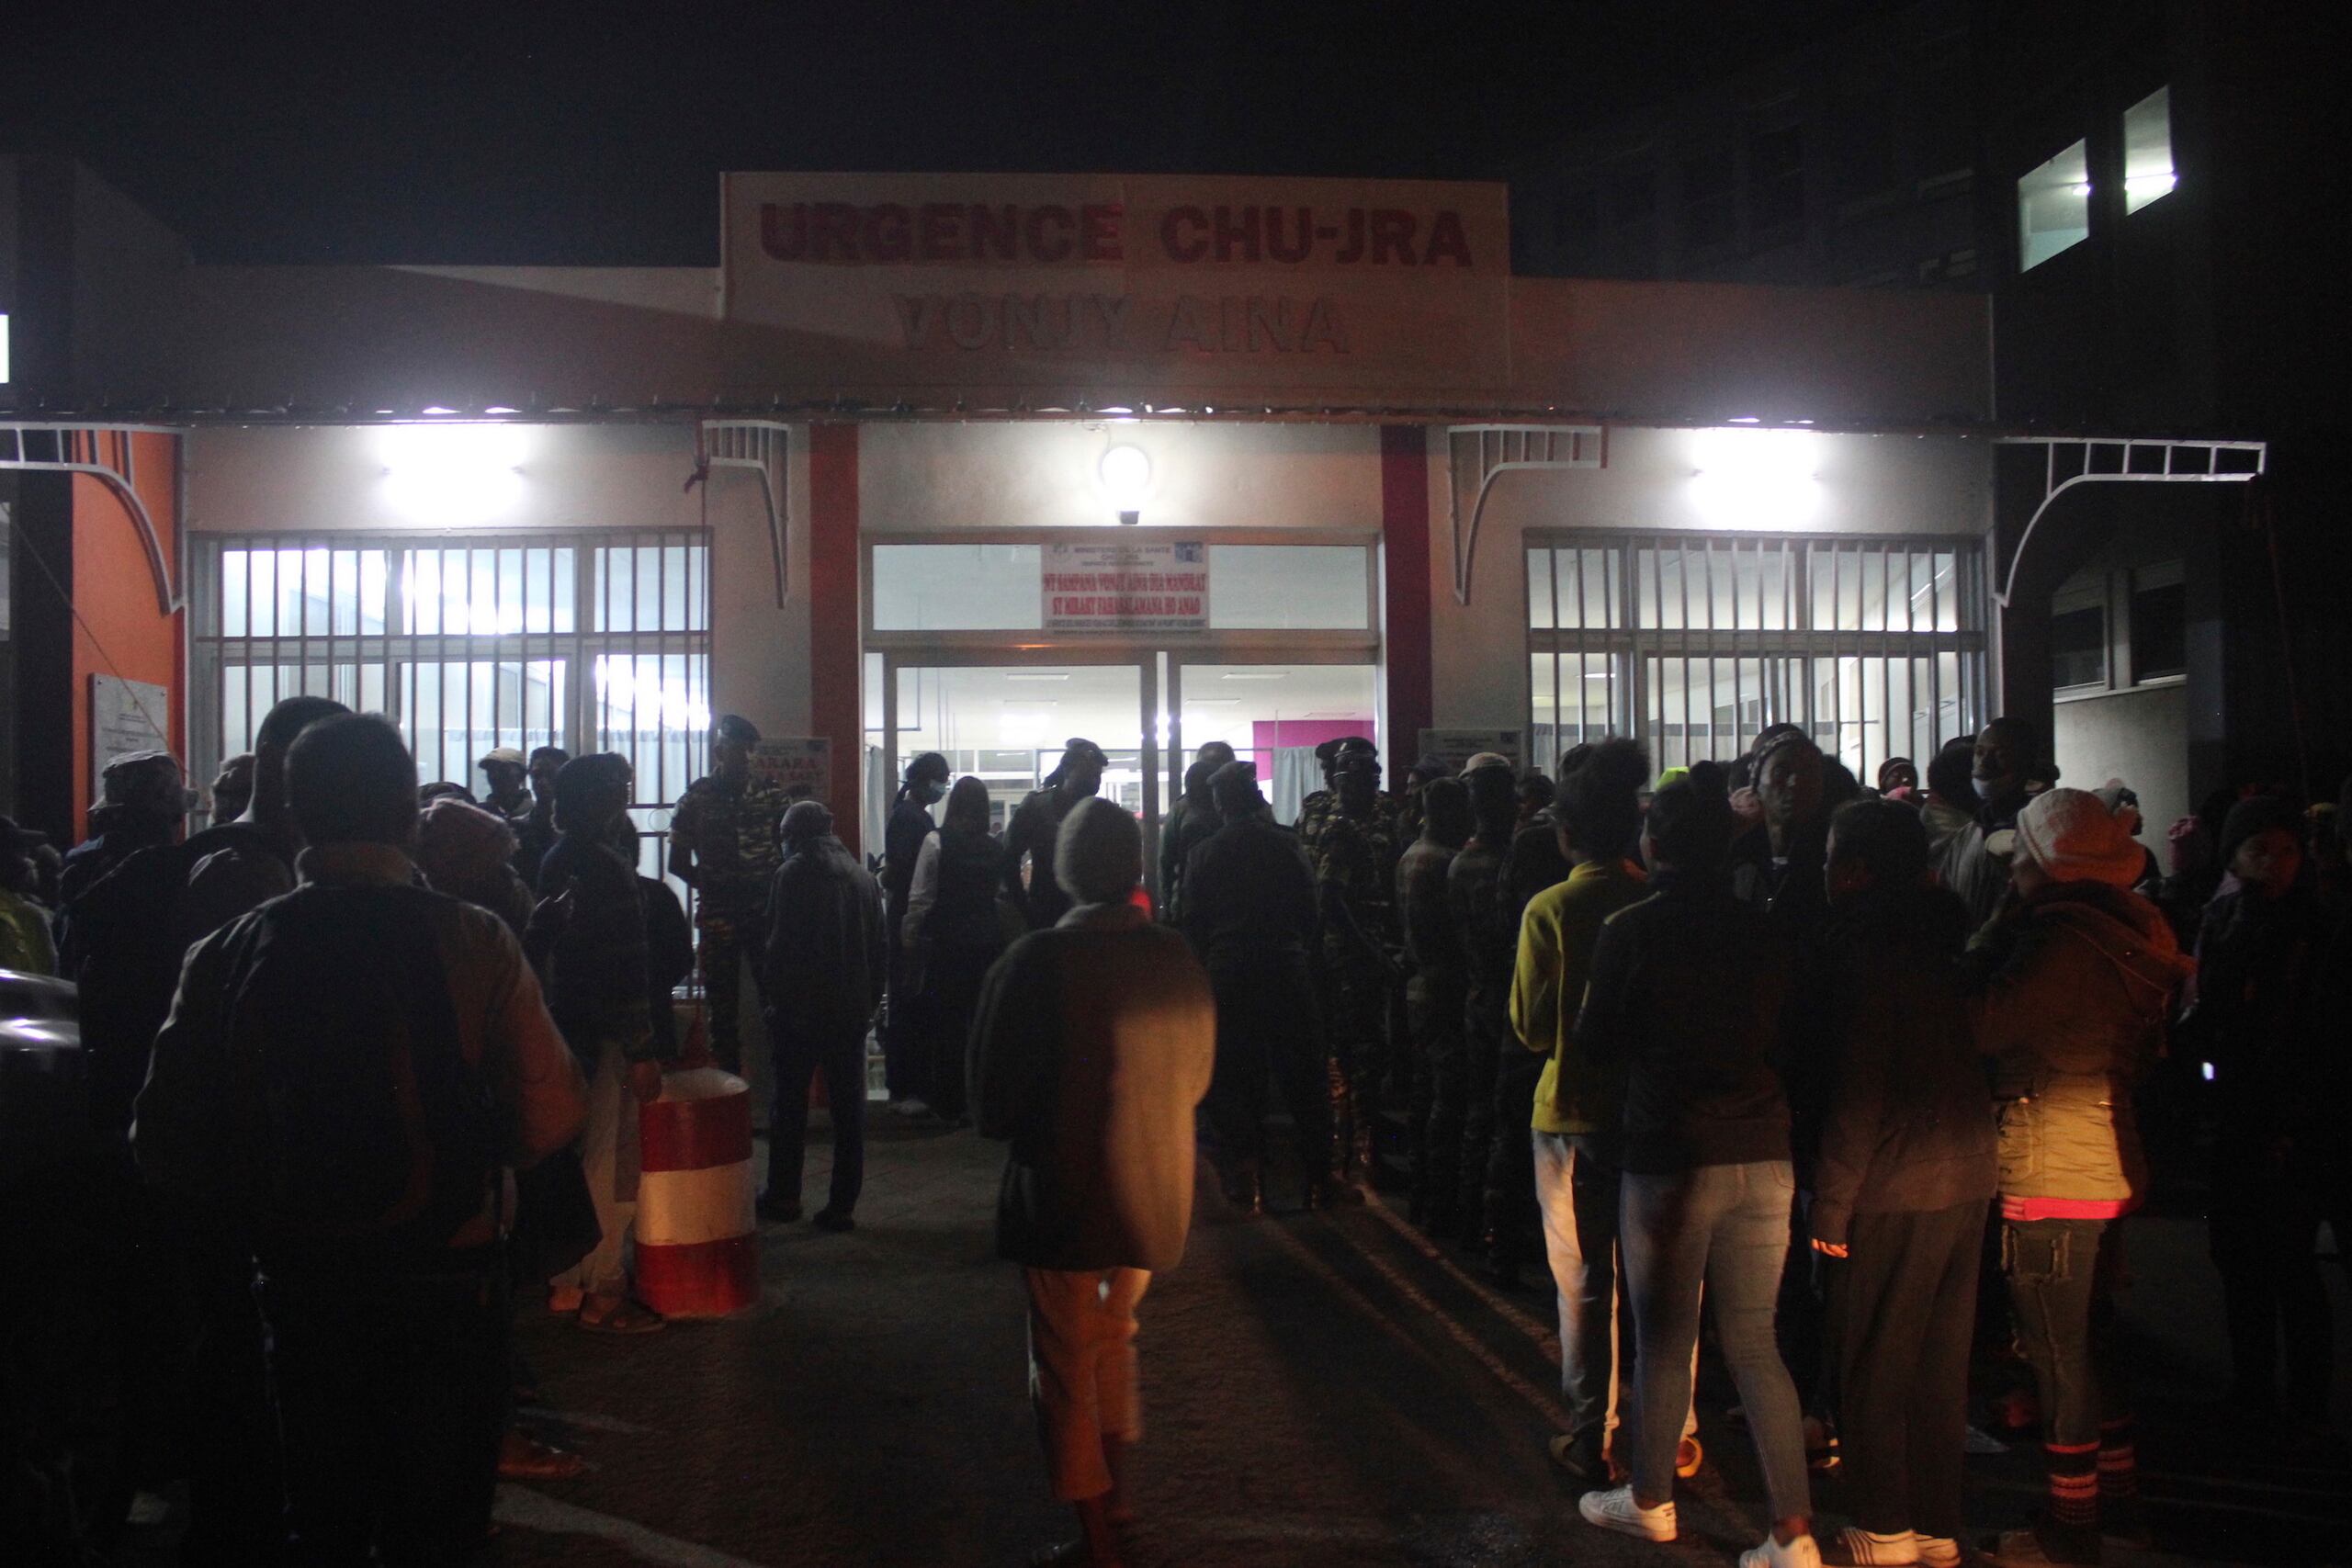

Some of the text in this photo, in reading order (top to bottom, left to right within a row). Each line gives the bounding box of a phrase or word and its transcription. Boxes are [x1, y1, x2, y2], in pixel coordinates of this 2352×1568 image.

[760, 202, 1473, 266] URGENCE CHU-JRA
[892, 291, 1351, 354] VONJY AINA
